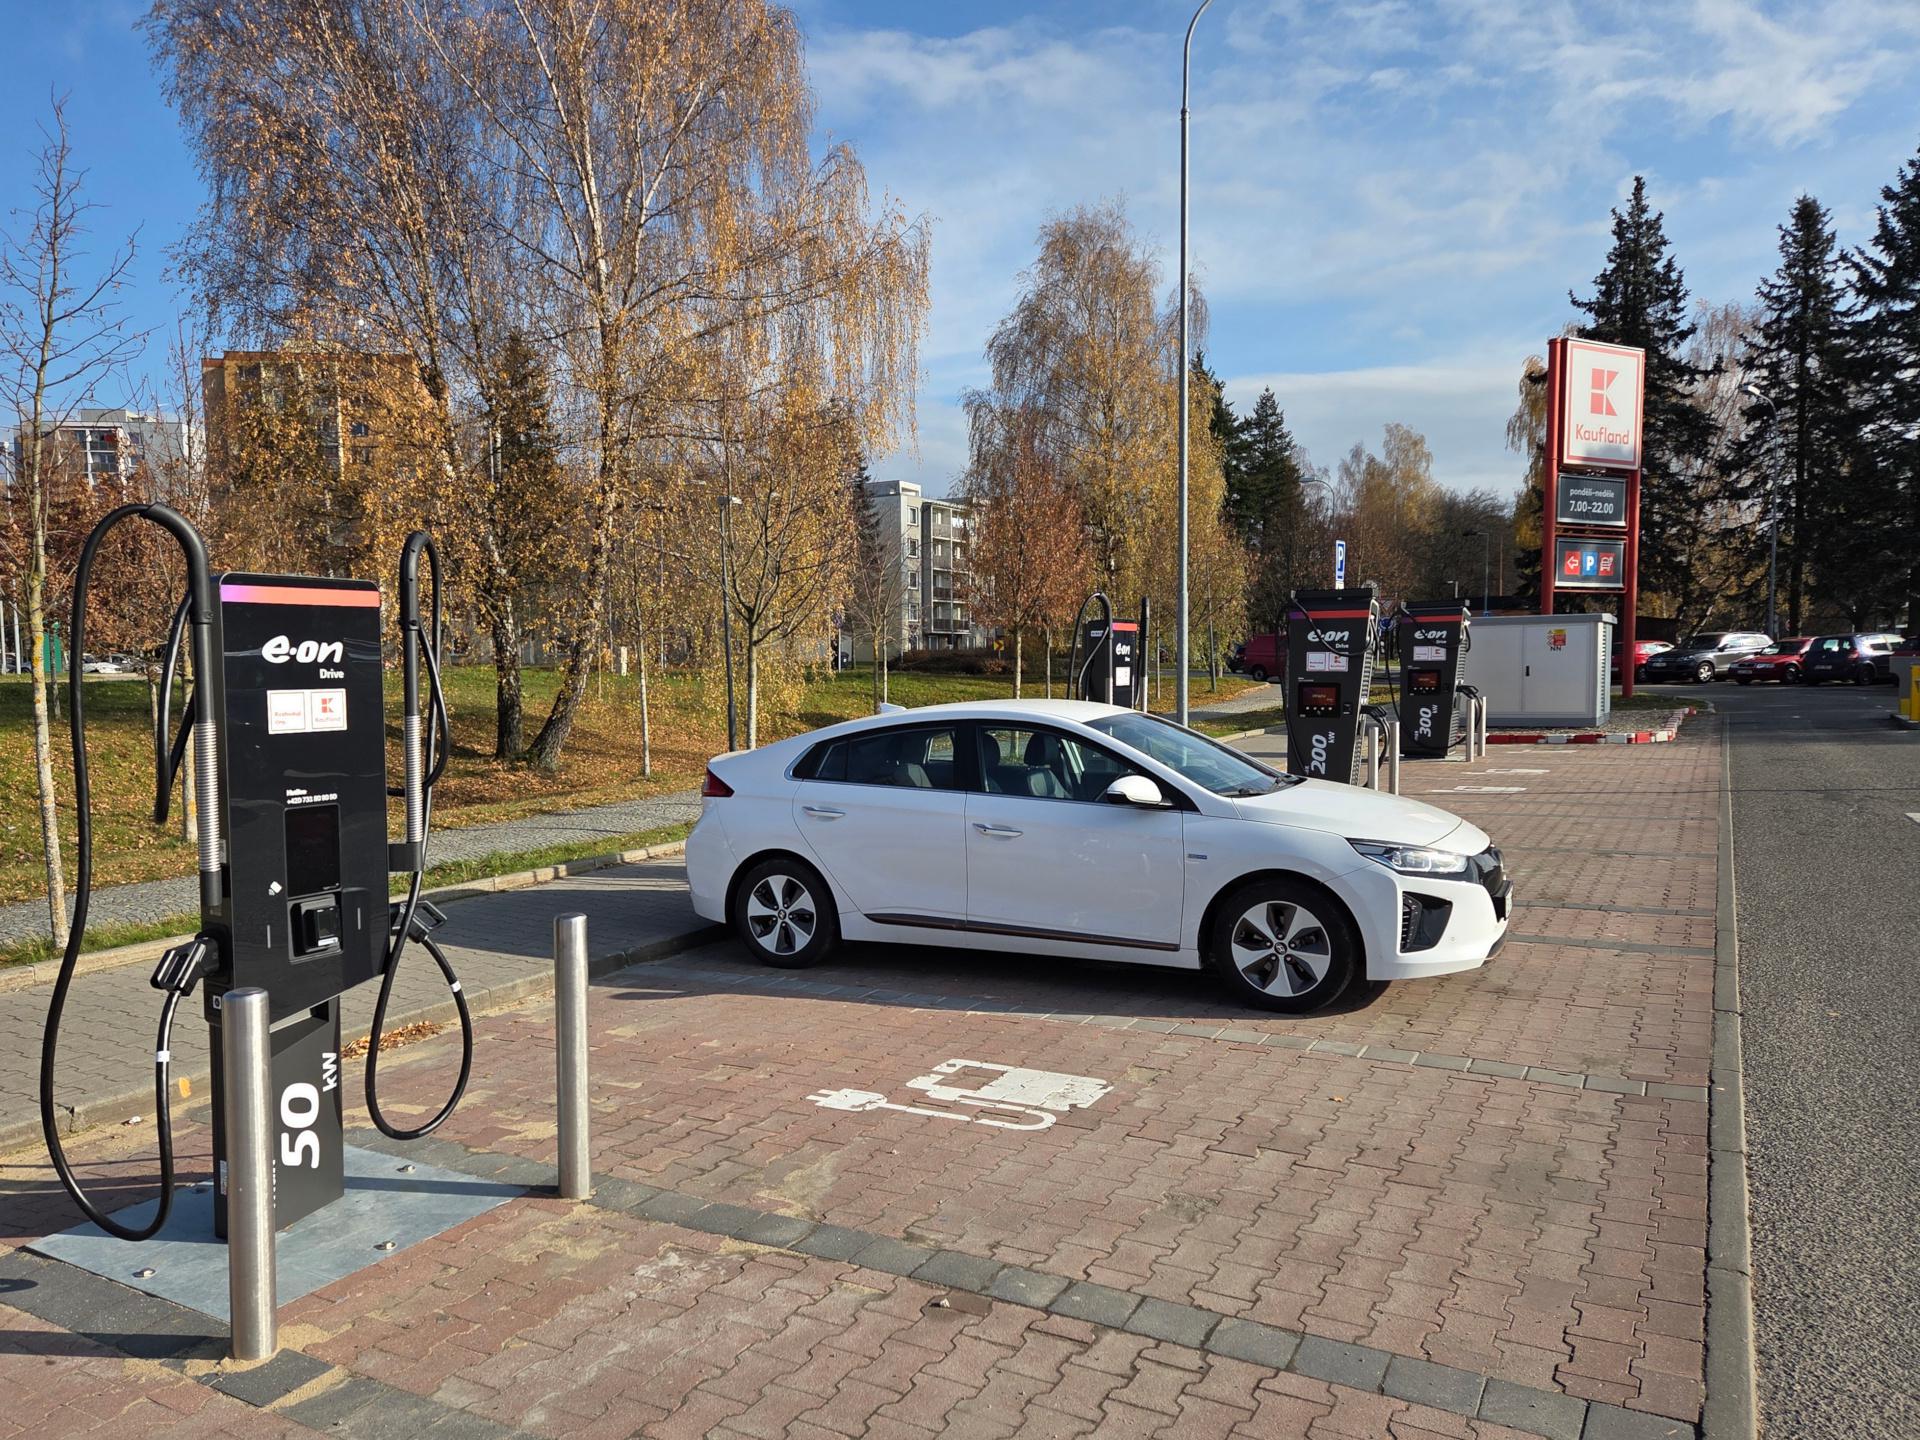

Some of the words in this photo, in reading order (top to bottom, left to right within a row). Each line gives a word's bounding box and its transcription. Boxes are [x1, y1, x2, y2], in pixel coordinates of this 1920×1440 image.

[1576, 423, 1630, 445] Kaufland
[1586, 555, 1595, 571] P
[319, 668, 345, 679] Drive
[1419, 707, 1432, 737] 300
[1311, 734, 1327, 775] 200
[322, 1052, 337, 1092] kW
[280, 1082, 320, 1169] 50
